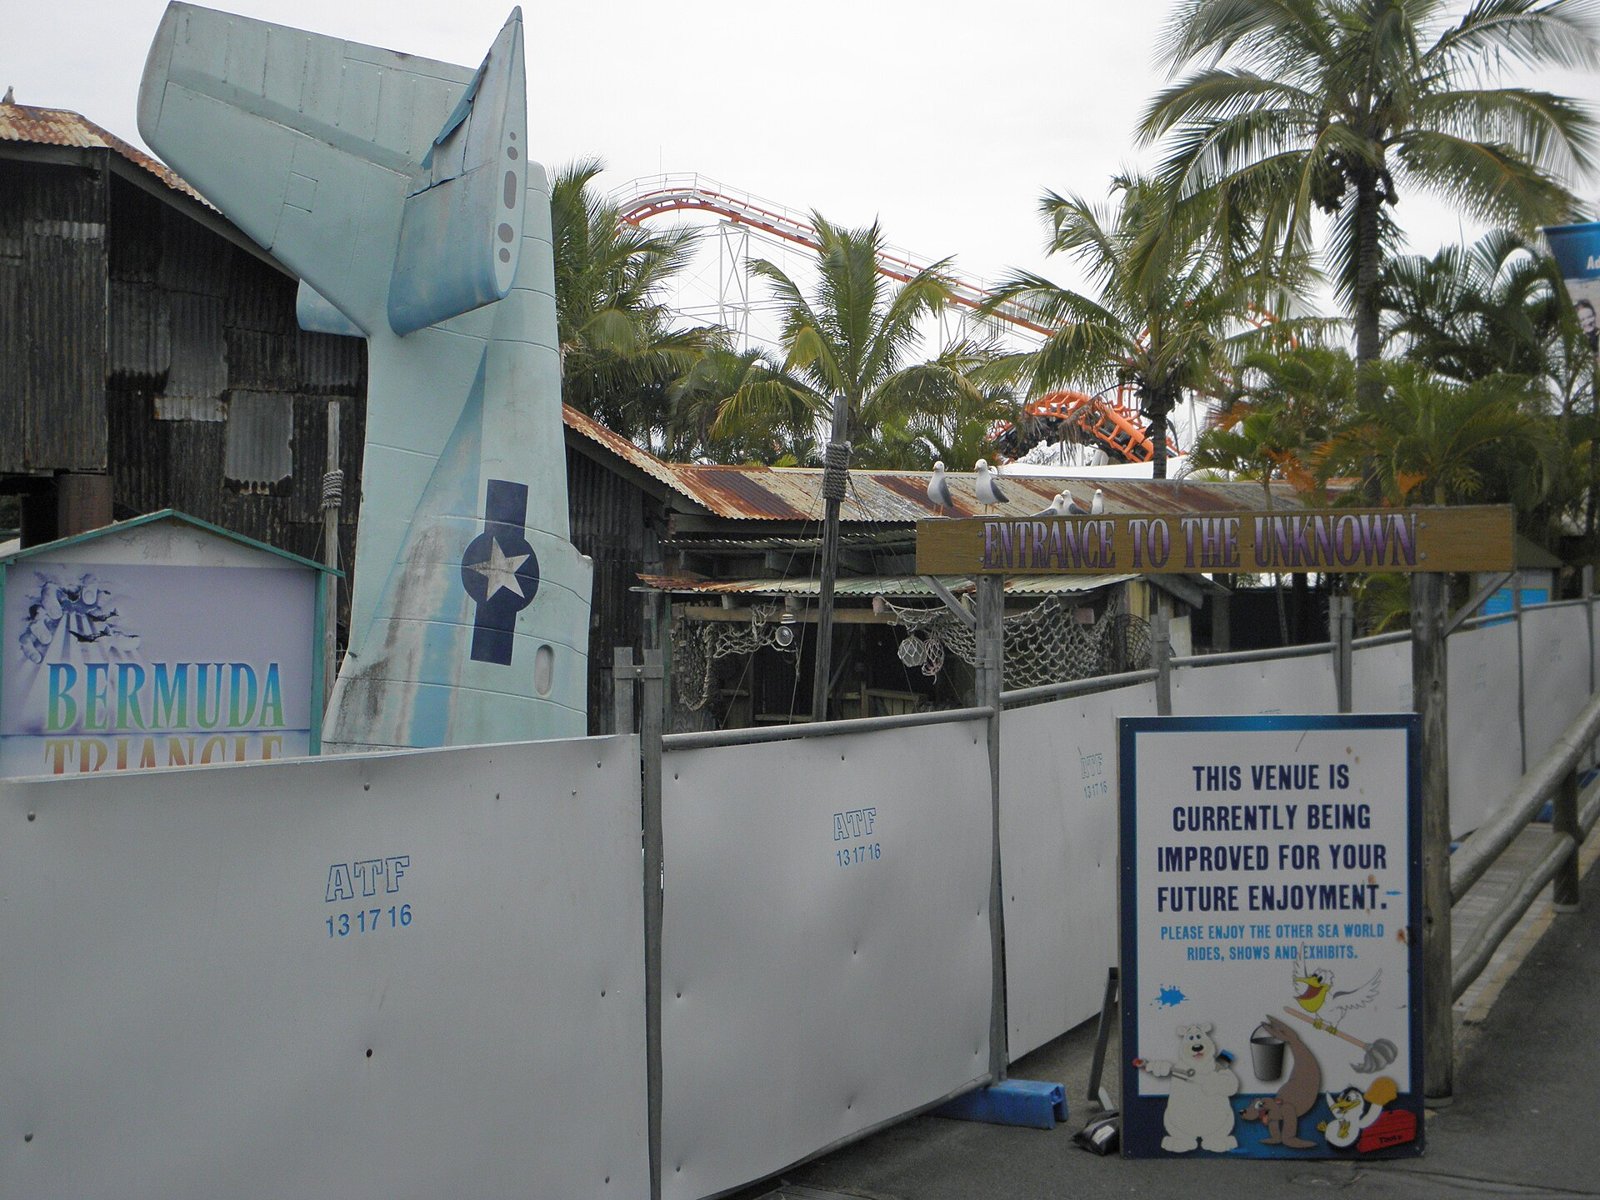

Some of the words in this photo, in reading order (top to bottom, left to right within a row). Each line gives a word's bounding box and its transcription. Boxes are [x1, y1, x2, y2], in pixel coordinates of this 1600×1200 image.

[981, 520, 1116, 569] ENTRANCE
[1128, 519, 1170, 568] TO
[1180, 517, 1241, 568] THE
[1254, 513, 1418, 567] UNKNOWN
[46, 662, 286, 731] BERMUDA
[1192, 765, 1242, 791] THIS
[1251, 764, 1319, 791] VENUE
[1329, 764, 1350, 789] IS
[833, 807, 876, 841] ATF
[1172, 805, 1298, 832] CURRENTLY
[1307, 804, 1371, 829] BEING
[1157, 845, 1269, 872] IMPROVED
[1279, 844, 1320, 870] FOR
[1329, 844, 1387, 870] YOUR
[325, 855, 410, 902] ATF
[1157, 885, 1240, 912] FUTURE
[1248, 884, 1388, 911] ENJOYMENT.
[326, 913, 350, 938] 13
[357, 908, 381, 932] 17
[388, 904, 412, 927] 16
[1160, 925, 1204, 940] PLEASE
[1208, 925, 1245, 939] ENJOY
[1249, 925, 1271, 939] THE
[1276, 924, 1313, 938] OTHER
[1318, 924, 1339, 938] SEA
[1344, 923, 1385, 938] WORLD
[1187, 946, 1225, 962] RIDES,
[1229, 946, 1270, 960] SHOWS
[1274, 946, 1298, 959] AND
[1303, 945, 1358, 959] EXHIBITS.
